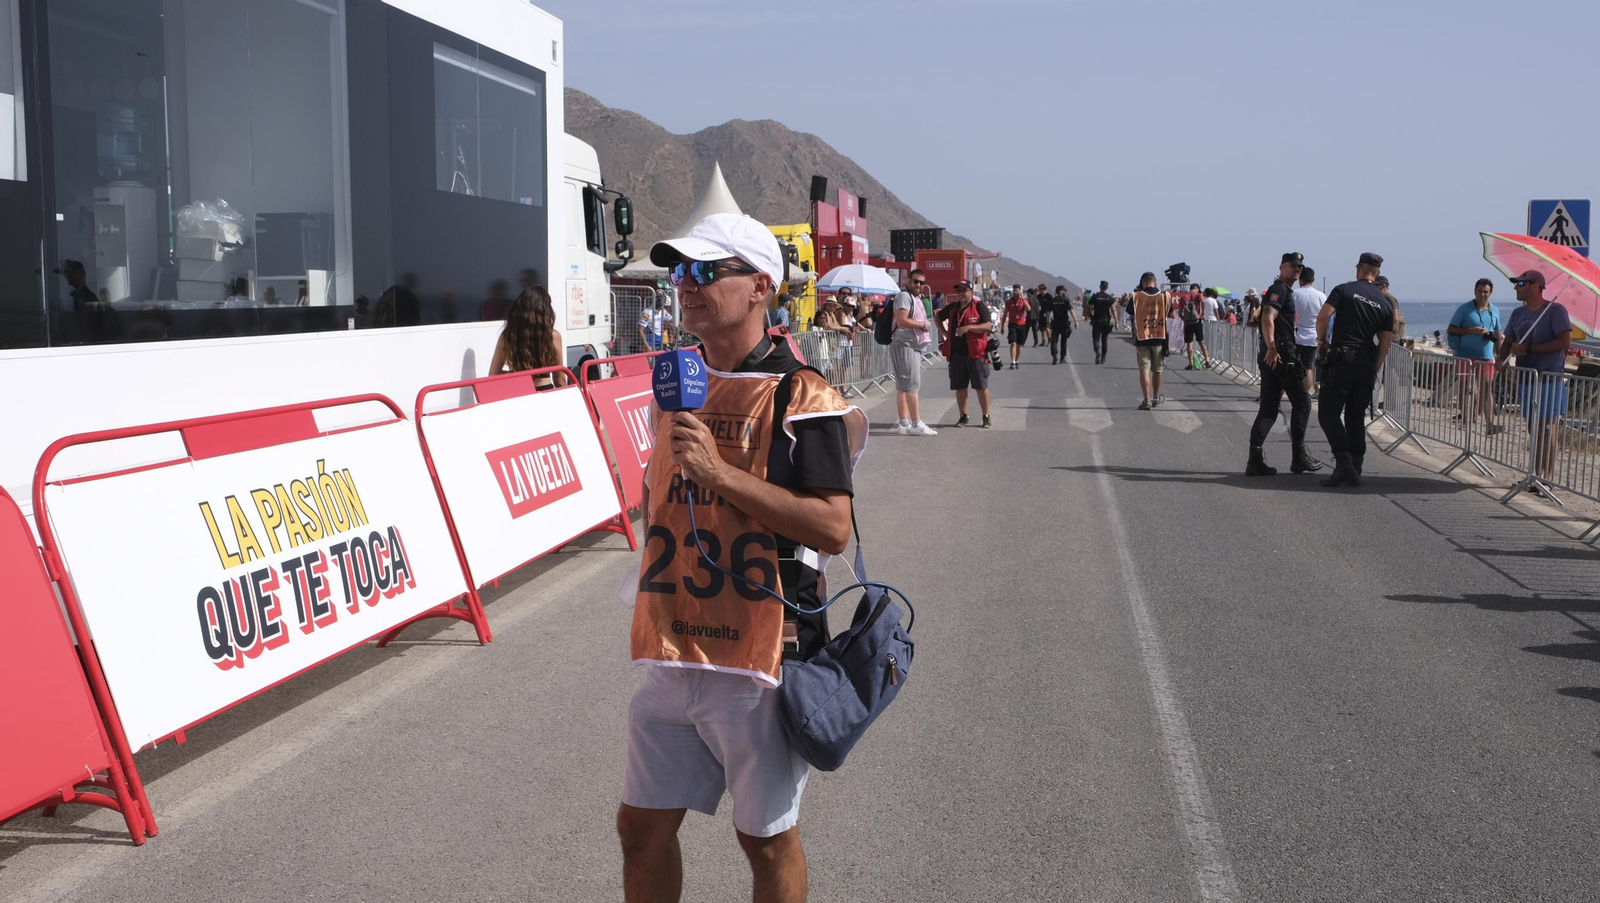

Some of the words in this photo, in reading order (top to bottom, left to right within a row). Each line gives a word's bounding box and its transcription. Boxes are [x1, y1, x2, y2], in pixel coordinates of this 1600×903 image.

[656, 381, 678, 391] Dipalme
[661, 390, 676, 398] Radio
[683, 378, 705, 387] Dipalme
[687, 386, 703, 395] Radio
[699, 418, 753, 443] UELTA
[500, 457, 530, 505] LA
[519, 443, 575, 497] VUELTA
[198, 494, 265, 570] LA
[250, 458, 370, 554] PASIÓN
[639, 525, 777, 602] 236
[196, 565, 289, 671] QUE
[281, 548, 338, 635] TE
[329, 524, 417, 615] TOCA
[671, 620, 740, 641] @lavuelta
